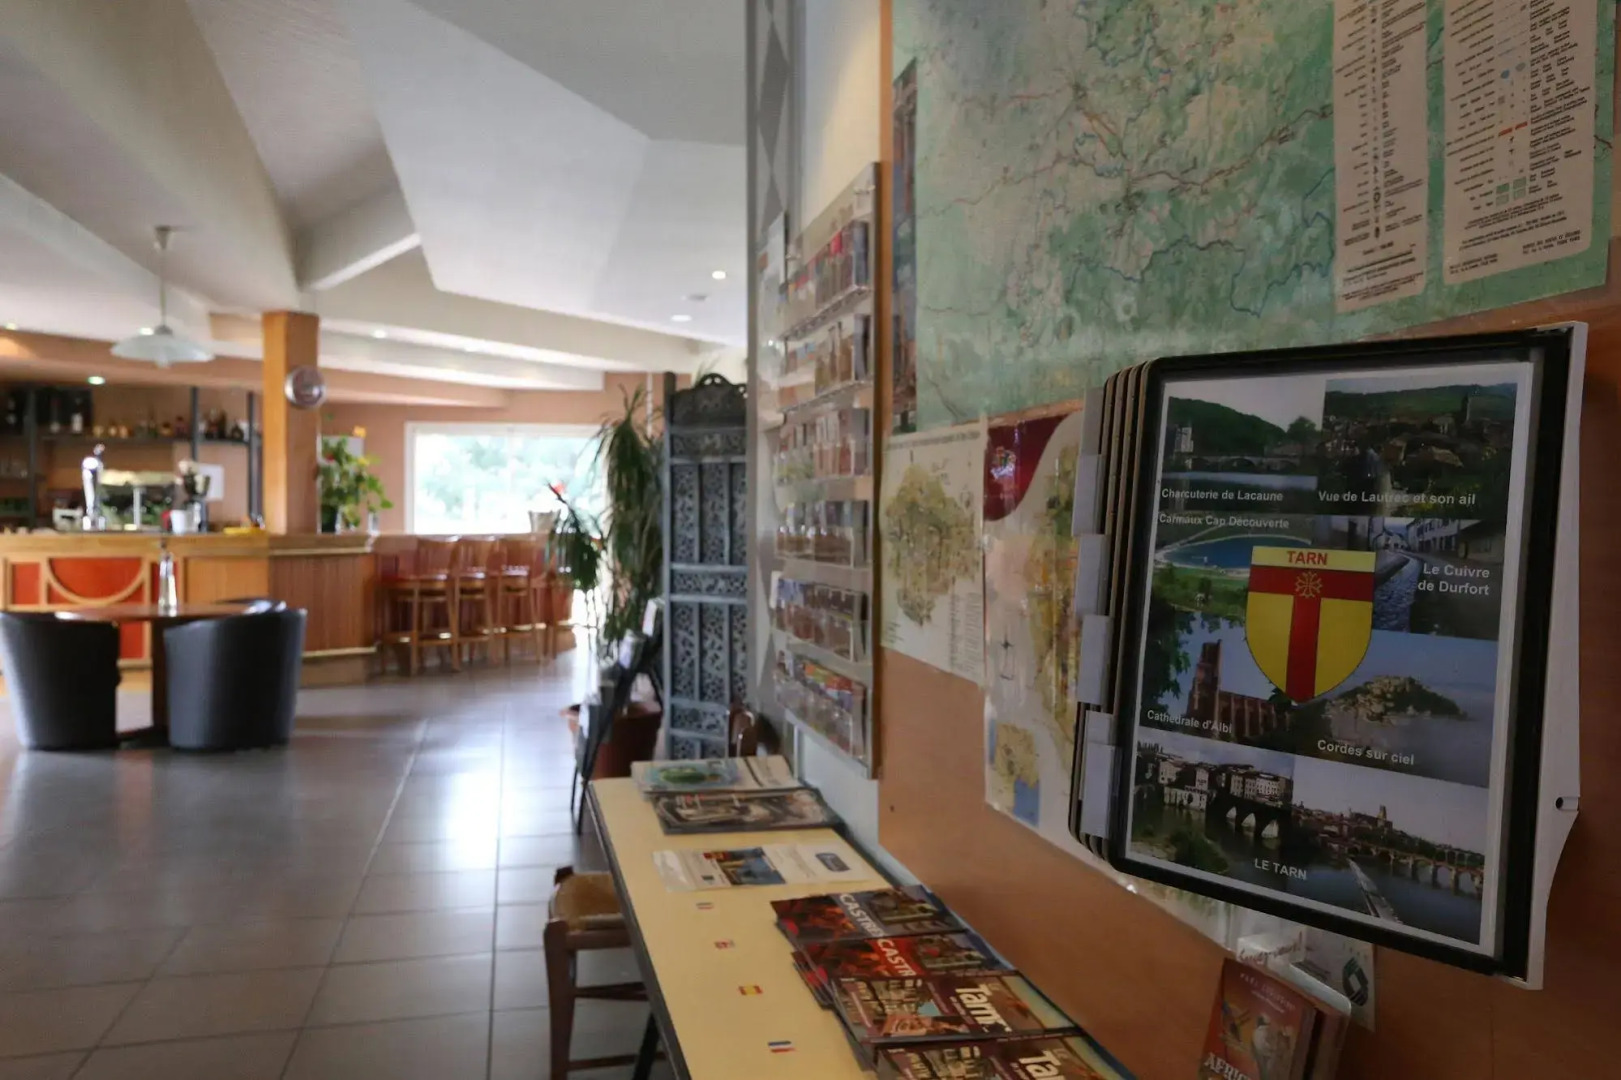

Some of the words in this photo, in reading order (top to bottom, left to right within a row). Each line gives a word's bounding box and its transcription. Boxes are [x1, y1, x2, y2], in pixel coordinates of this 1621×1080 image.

[1161, 488, 1219, 500] Charcuterie
[1221, 489, 1234, 500] de
[1237, 489, 1284, 502] Lacaune
[1318, 490, 1340, 502] Vue
[1343, 491, 1358, 502] de
[1413, 493, 1427, 504] et
[1429, 494, 1455, 505] son
[1458, 493, 1476, 506] ail
[1205, 515, 1226, 527] Cap
[1287, 550, 1328, 566] TARN
[1423, 563, 1439, 575] Le
[1444, 564, 1490, 578] Cuivre
[1417, 579, 1435, 591] de
[1438, 580, 1490, 596] Durfort
[1317, 739, 1362, 757] Cordes
[1366, 748, 1388, 761] sur
[1391, 752, 1415, 766] ciel
[1254, 858, 1270, 871] LE
[1272, 861, 1307, 881] TARN
